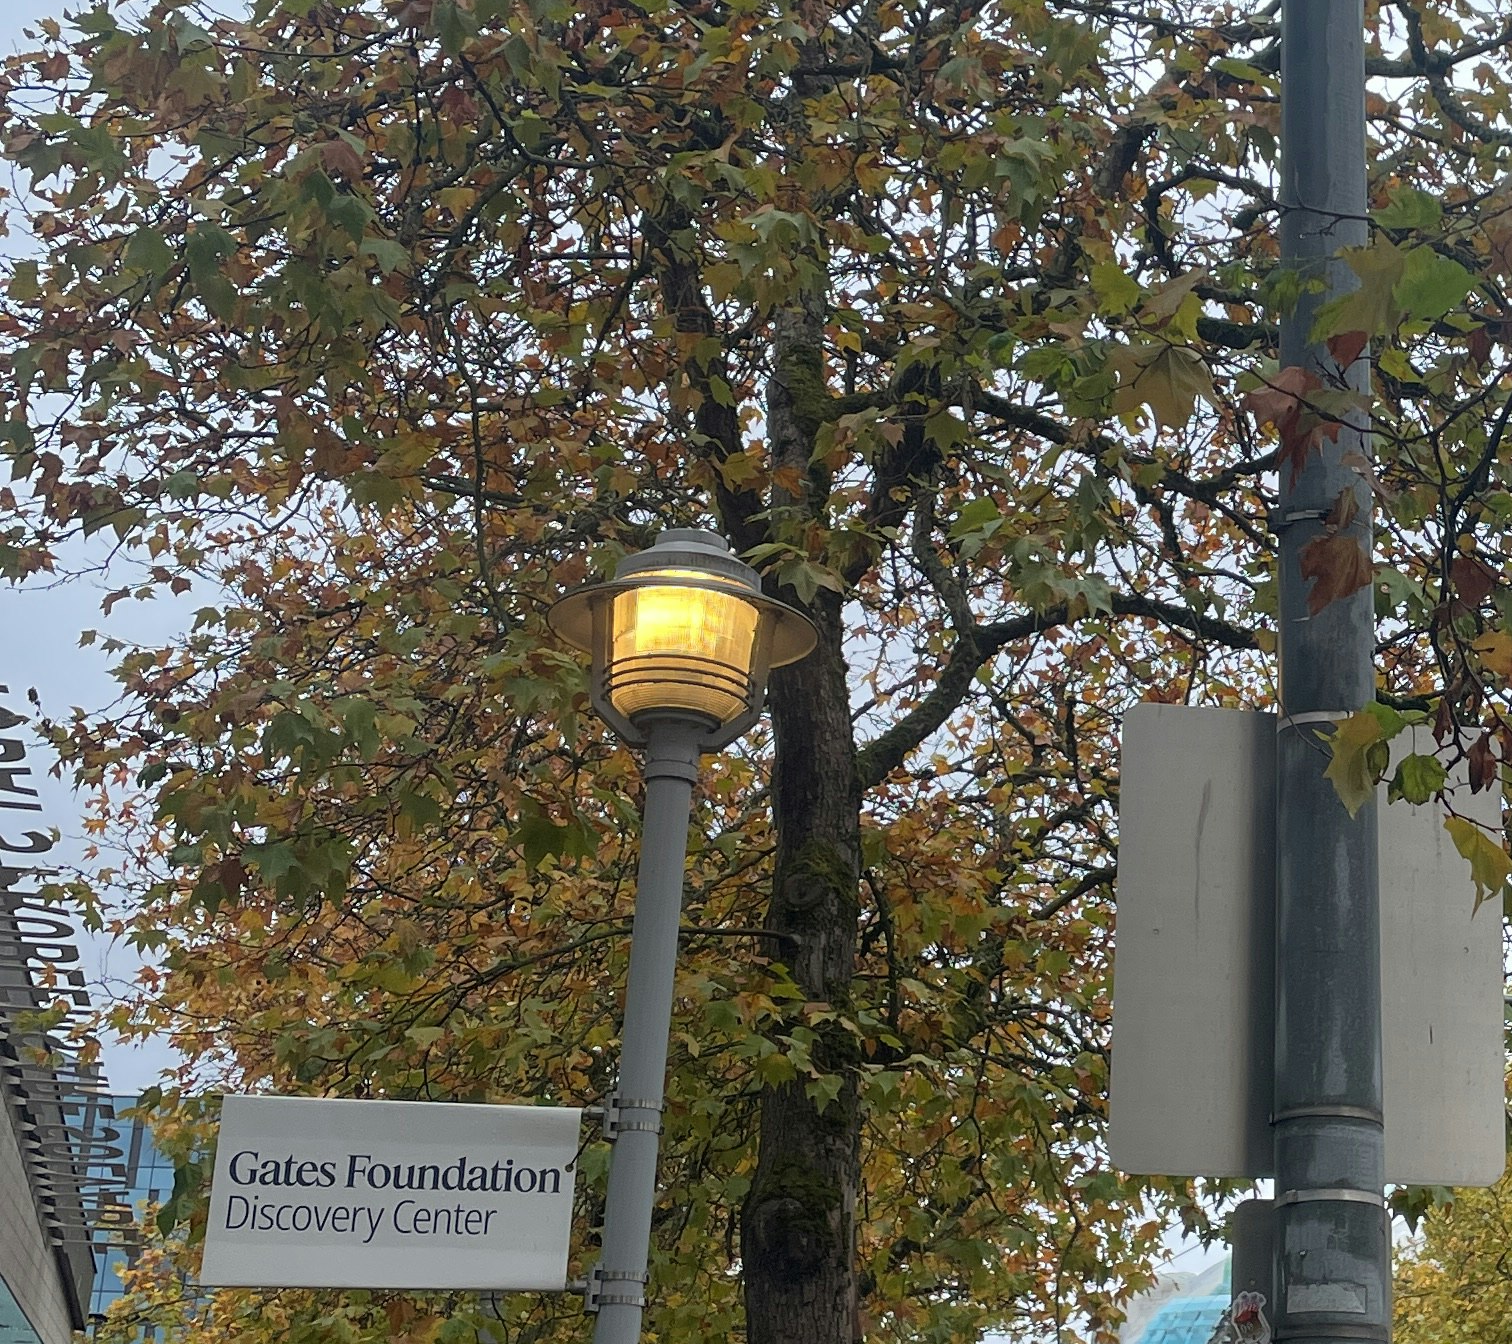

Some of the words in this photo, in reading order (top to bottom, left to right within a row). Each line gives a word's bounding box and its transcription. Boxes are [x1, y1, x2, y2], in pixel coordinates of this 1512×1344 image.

[229, 1151, 335, 1188] Gates
[344, 1154, 560, 1193] Foundation
[225, 1195, 384, 1243] Discovery
[393, 1200, 497, 1235] Center
